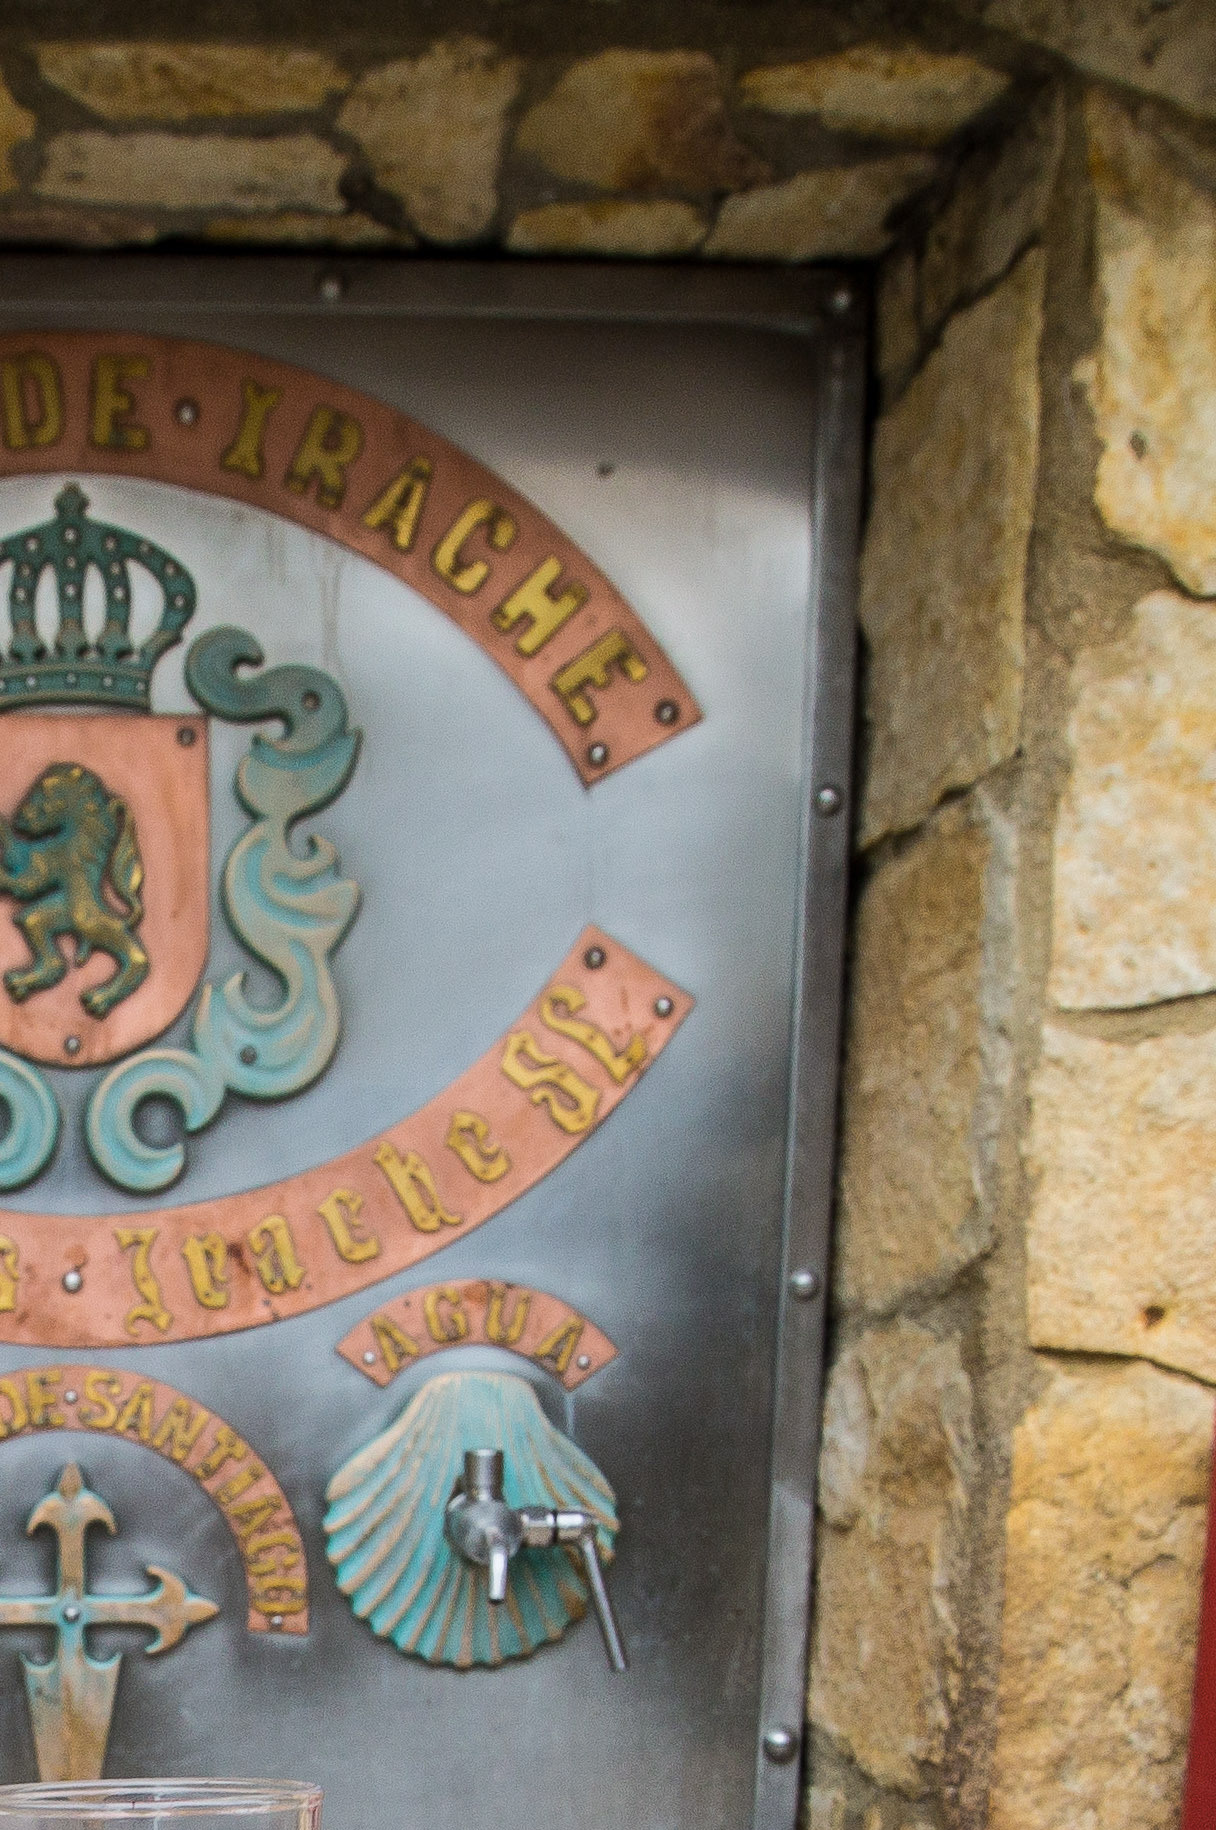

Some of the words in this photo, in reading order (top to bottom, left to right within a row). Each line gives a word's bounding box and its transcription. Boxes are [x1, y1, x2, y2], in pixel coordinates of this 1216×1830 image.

[0, 350, 153, 451] DE
[221, 376, 648, 728] IRACHE
[115, 1110, 511, 1337] Irache
[368, 1283, 583, 1373] AGUA
[80, 1370, 306, 1615] SANTIAGO
